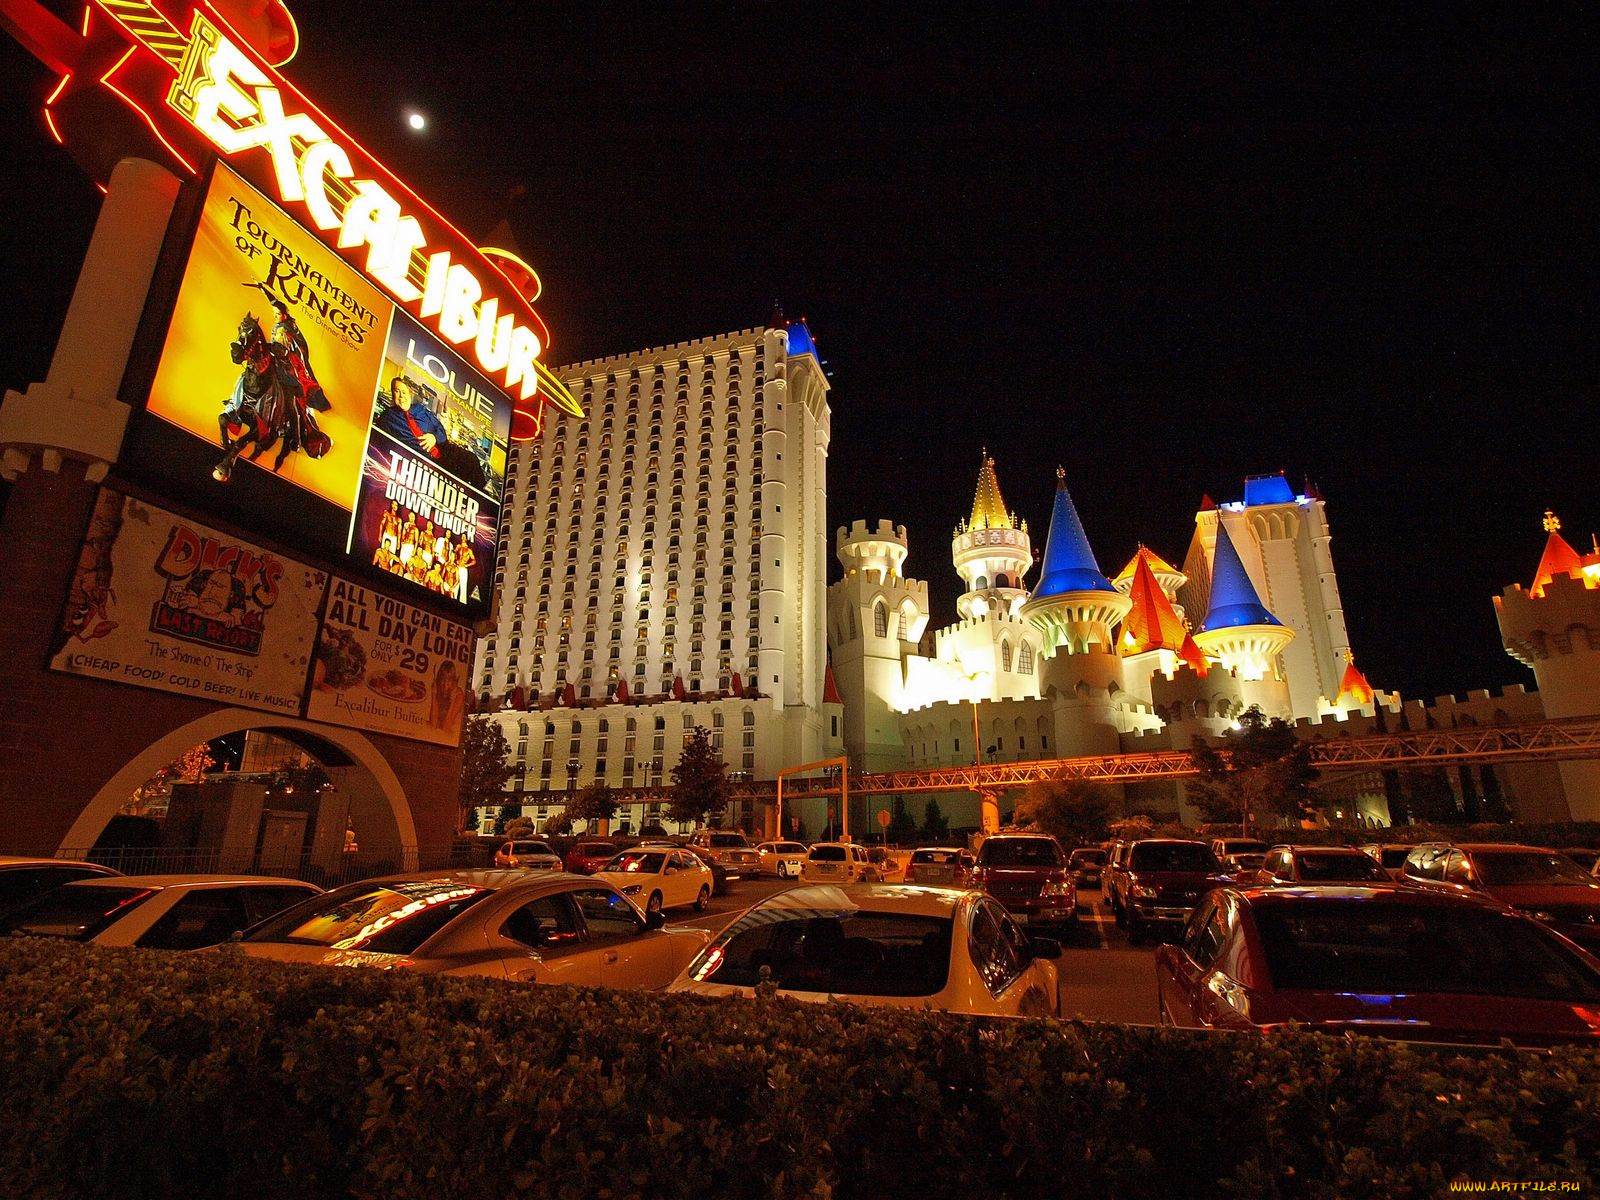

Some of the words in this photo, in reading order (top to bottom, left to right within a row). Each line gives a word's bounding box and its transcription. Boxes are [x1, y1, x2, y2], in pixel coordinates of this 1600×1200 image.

[166, 8, 541, 400] EXCALIBUR
[228, 196, 378, 329] TOURNAMENT
[235, 235, 263, 260] OF
[264, 253, 368, 344] KINGS
[301, 306, 314, 320] The
[315, 315, 339, 338] Dinner
[340, 330, 360, 352] Show
[407, 338, 494, 421] LOUIE
[447, 389, 474, 414] THAN
[473, 410, 493, 428] LIFE
[385, 480, 432, 520] DOWN
[434, 510, 476, 544] UNDER
[389, 449, 480, 526] THUNDER
[159, 608, 203, 636] LAST
[205, 622, 258, 649] RESORT
[329, 600, 370, 632] ALL
[378, 616, 418, 646] DAY
[423, 630, 469, 665] LONG
[334, 582, 366, 607] ALL
[374, 594, 406, 620] YOU
[411, 608, 441, 634] CAN
[446, 623, 473, 644] EAT
[170, 646, 203, 667] Shame
[216, 657, 233, 673] The
[370, 650, 393, 664] ONLY
[374, 639, 392, 651] FOR
[74, 654, 120, 672] CHEAP
[124, 664, 166, 681] FOOD!
[169, 675, 201, 689] COLD
[204, 681, 236, 695] BEER!
[239, 688, 260, 701] LIVE
[263, 693, 297, 708] MUSIC!
[335, 692, 391, 721] Excalibur
[394, 706, 425, 726] Buffet
